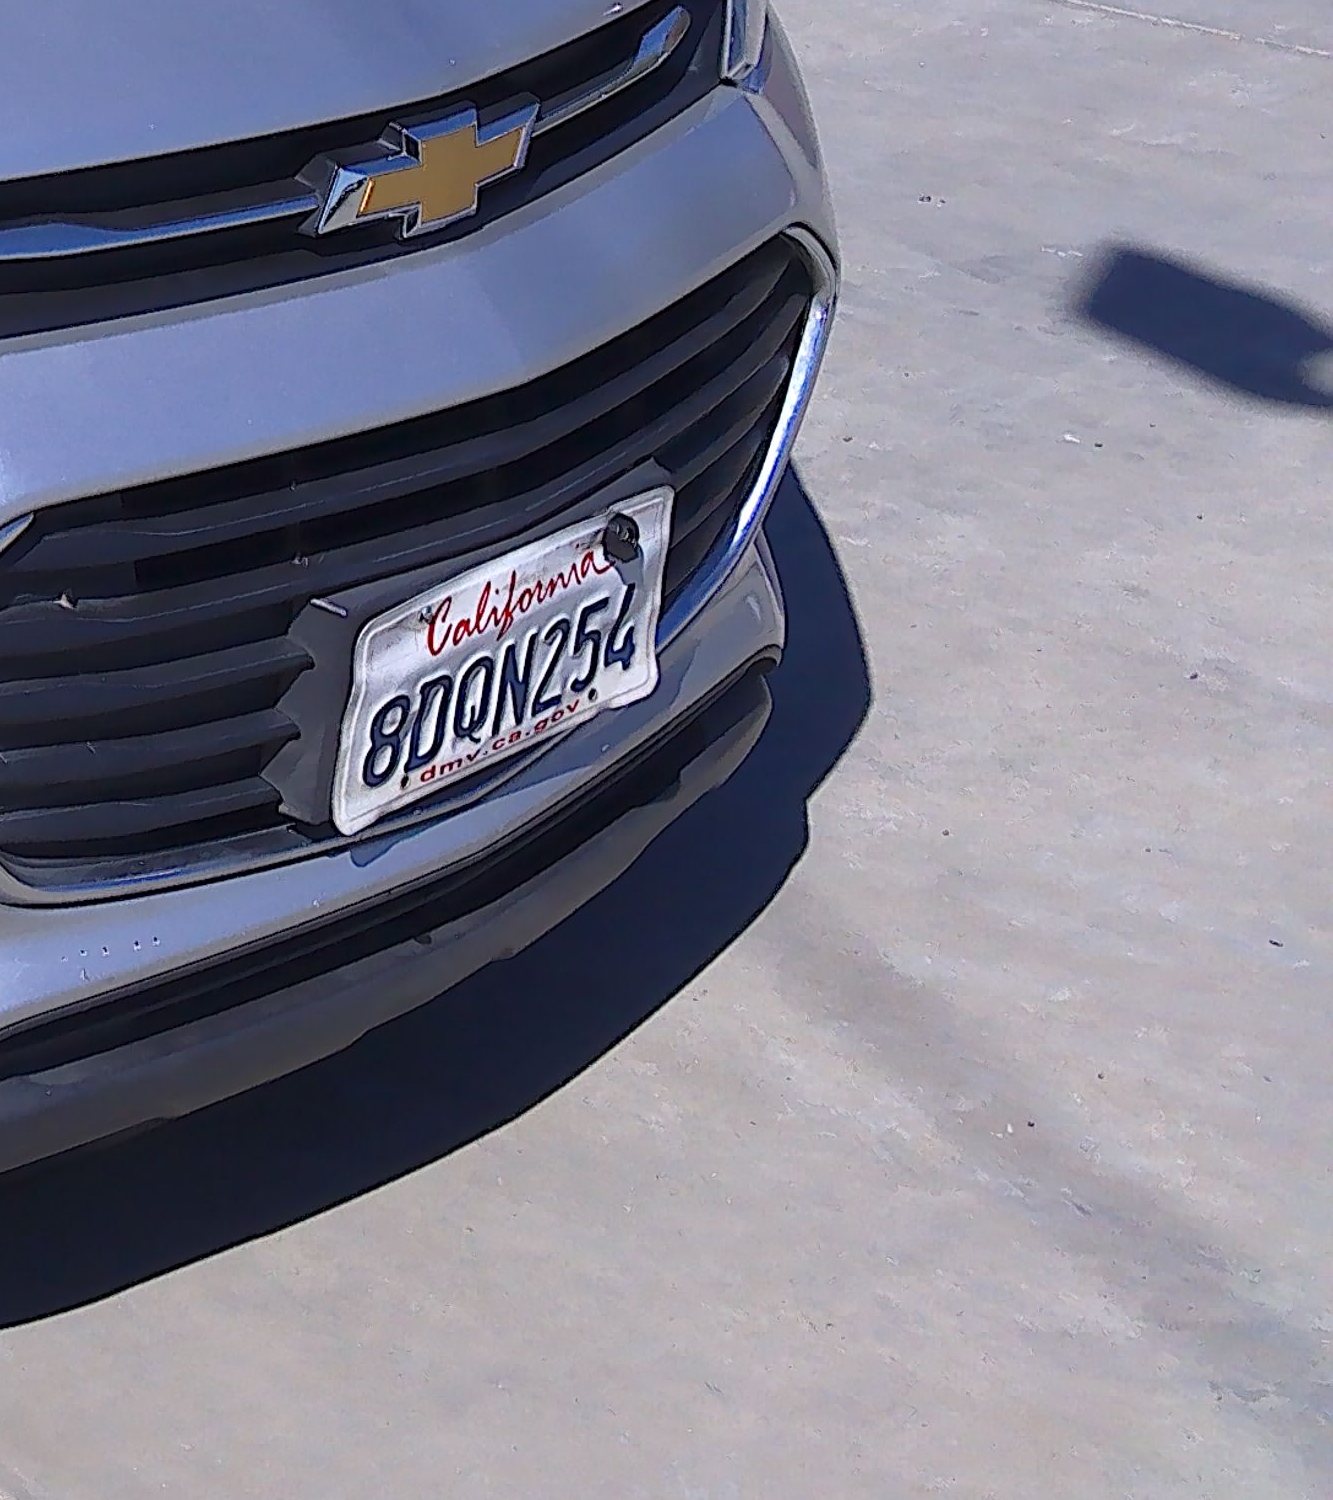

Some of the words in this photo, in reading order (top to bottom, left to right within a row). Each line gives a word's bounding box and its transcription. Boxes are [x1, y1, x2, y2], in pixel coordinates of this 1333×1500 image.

[427, 549, 614, 656] California
[362, 583, 637, 788] 8DQN254
[420, 699, 581, 783] dmv.ca.gov
